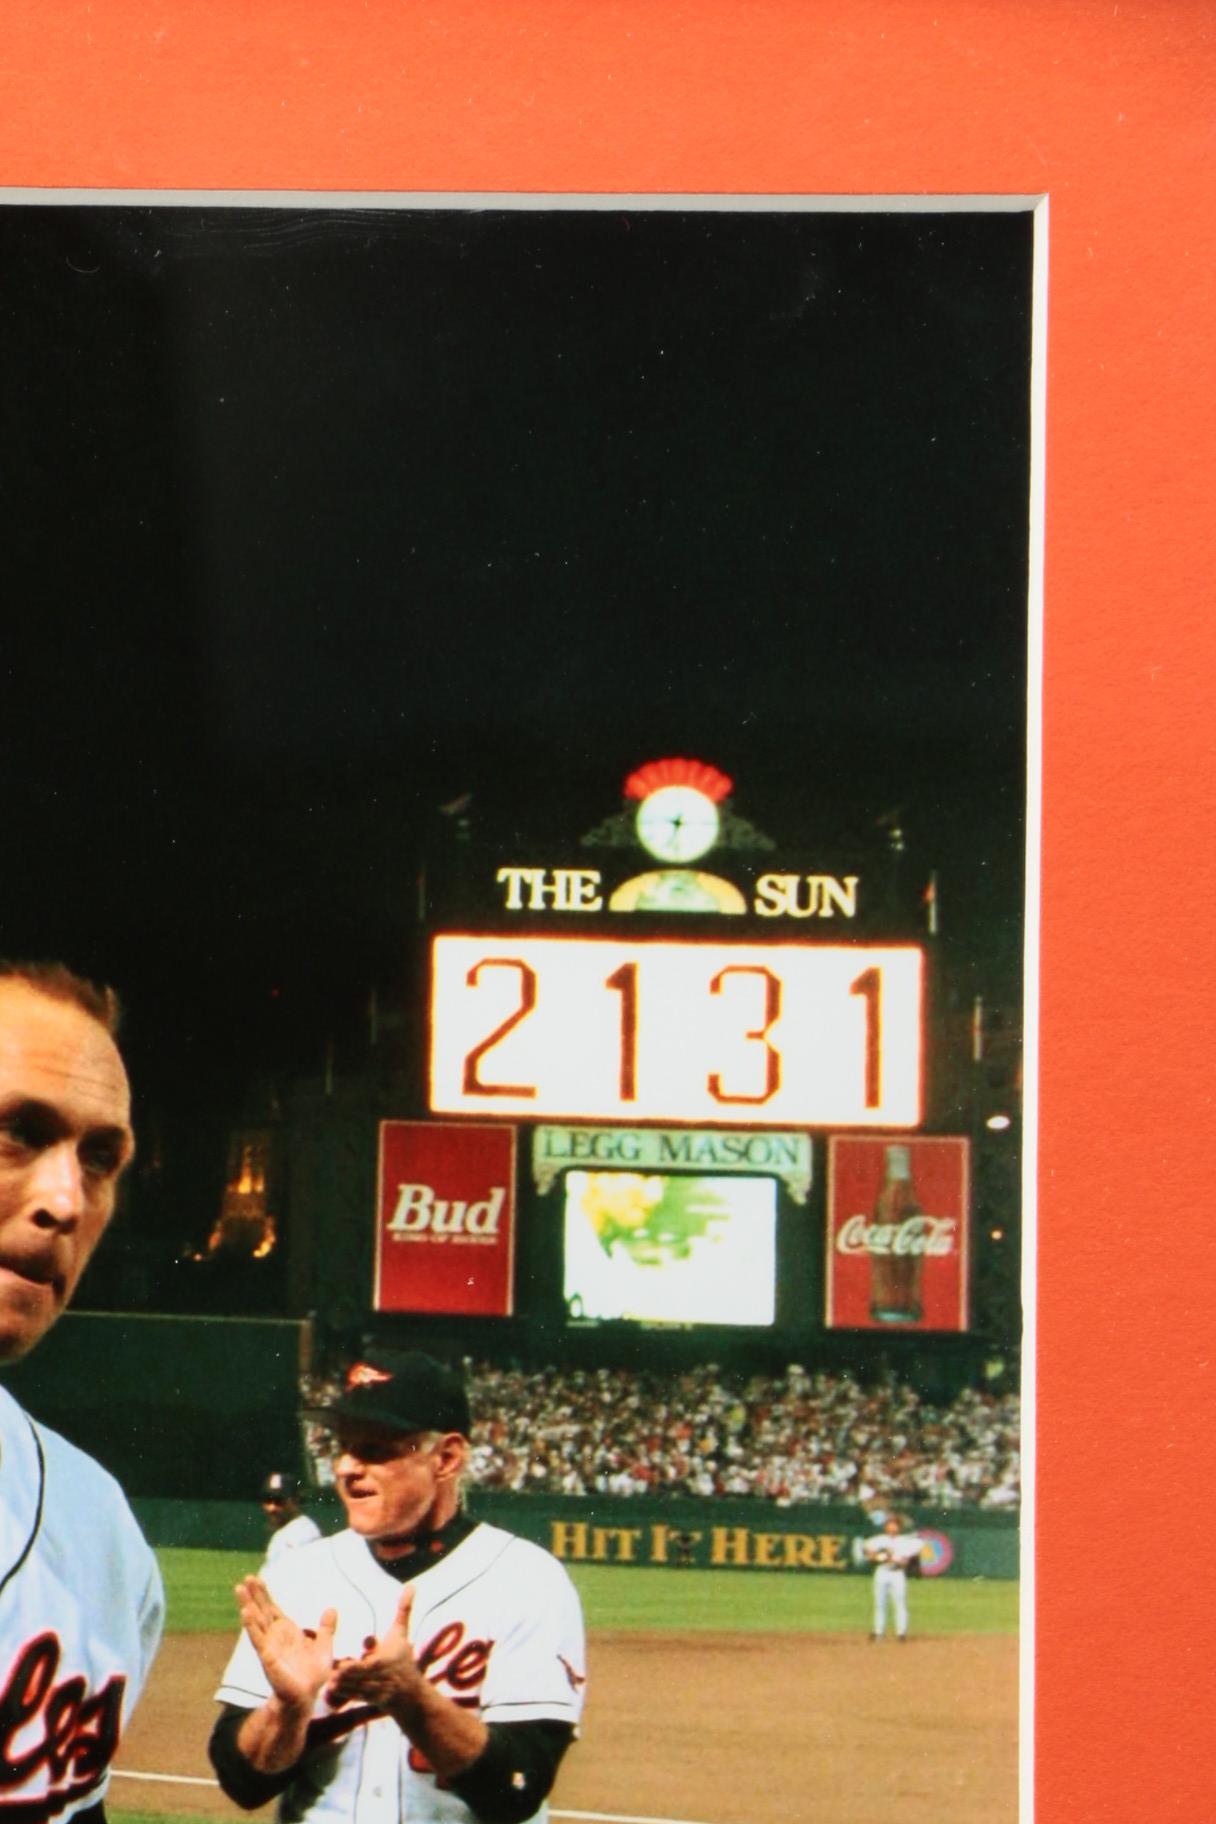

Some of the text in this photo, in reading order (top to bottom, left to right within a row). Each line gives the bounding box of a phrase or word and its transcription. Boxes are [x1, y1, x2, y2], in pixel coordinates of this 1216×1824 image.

[497, 868, 859, 918] THE SUN
[461, 957, 883, 1110] 2131
[543, 1129, 801, 1166] LEGG MASON
[386, 1183, 506, 1234] Bud
[710, 1526, 847, 1569] HERE
